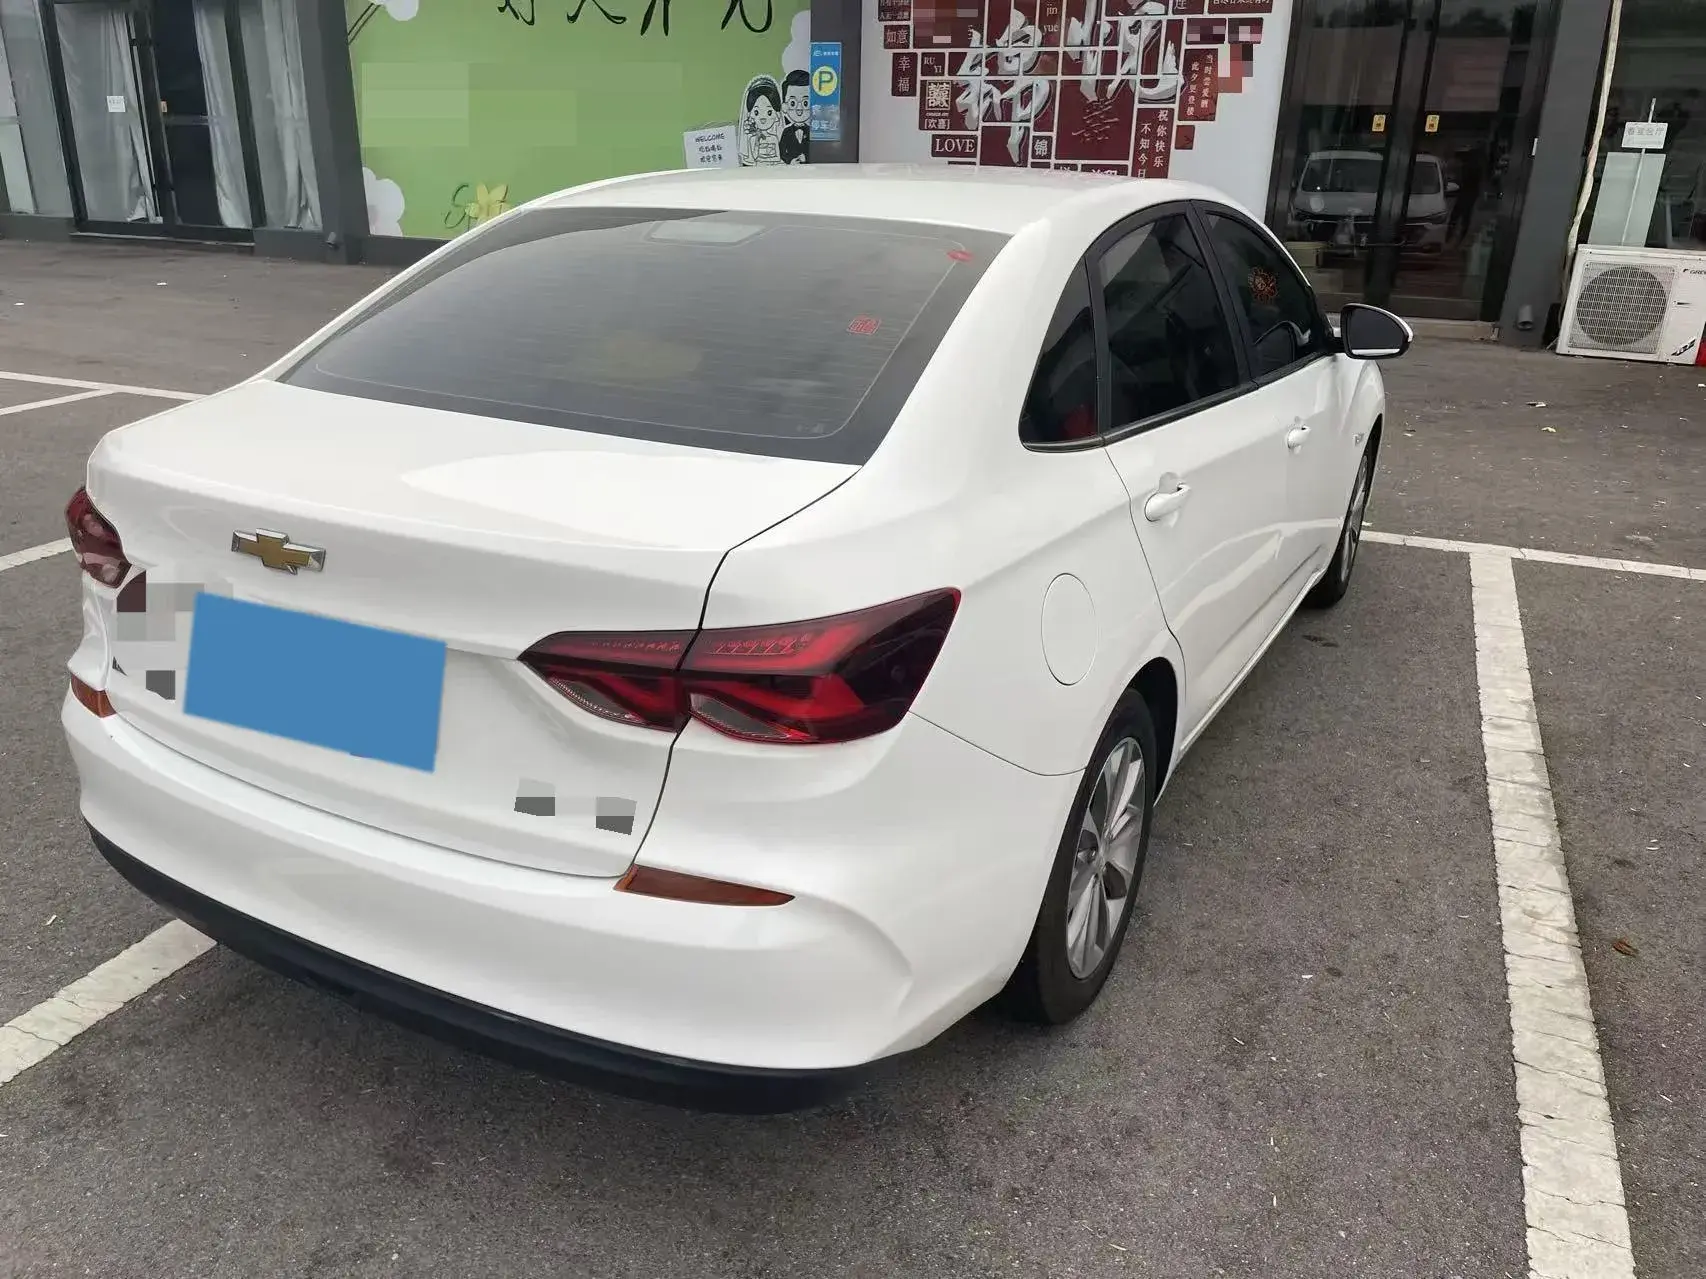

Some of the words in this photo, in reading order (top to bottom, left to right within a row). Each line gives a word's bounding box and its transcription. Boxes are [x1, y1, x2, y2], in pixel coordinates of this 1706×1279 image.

[886, 29, 909, 44] 如意
[1043, 24, 1059, 35] yue
[924, 57, 936, 65] RU
[819, 70, 833, 91] P
[898, 55, 911, 93] 幸福
[695, 132, 725, 143] WELCOME
[1152, 109, 1169, 168] 祝你快乐
[935, 138, 975, 153] LOVE
[1137, 122, 1151, 179] 不知今日
